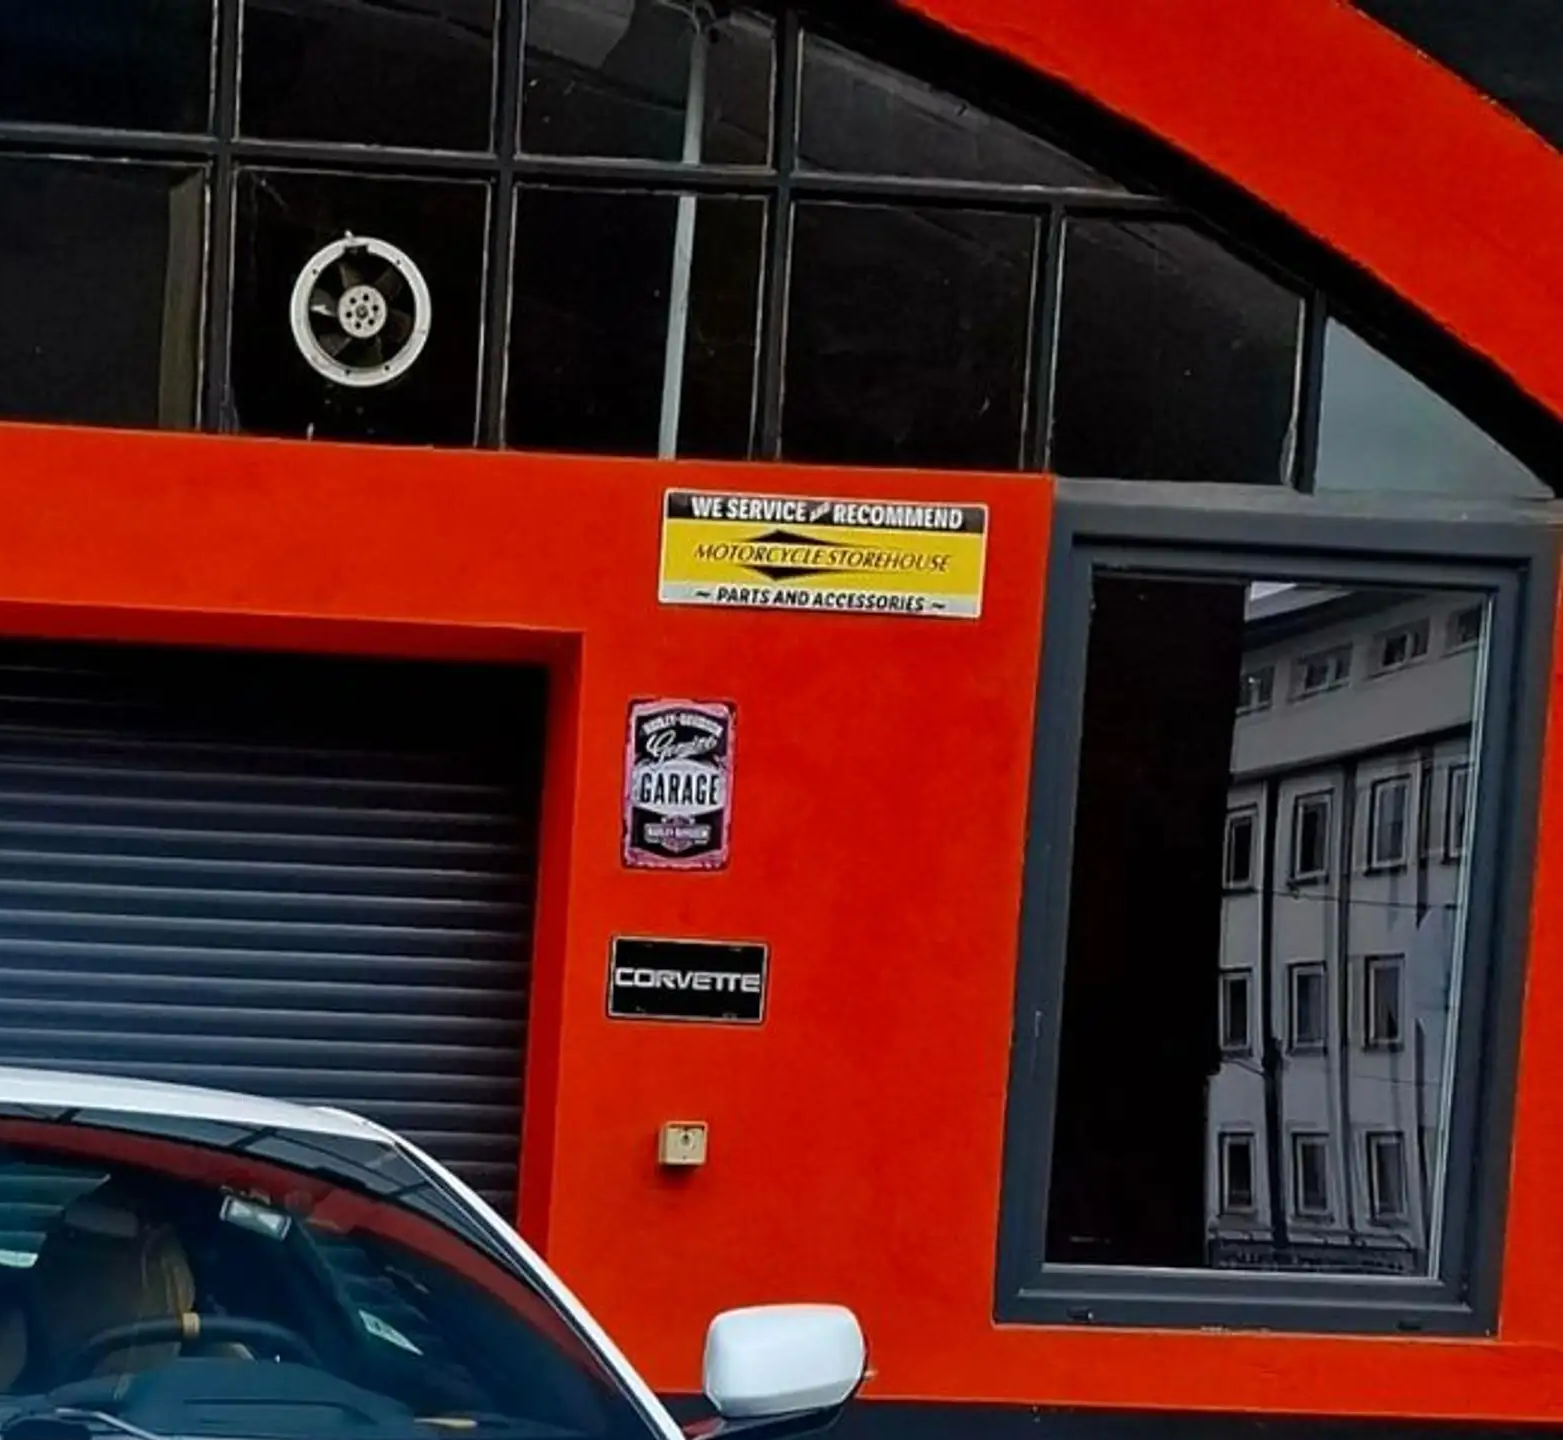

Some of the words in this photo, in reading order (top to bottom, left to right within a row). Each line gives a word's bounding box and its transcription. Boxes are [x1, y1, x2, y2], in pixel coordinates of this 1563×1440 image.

[691, 496, 726, 518] WE
[727, 498, 807, 523] SERVICE
[832, 504, 964, 530] RECOMMEND
[694, 543, 825, 567] MOTORCYCLE
[827, 548, 952, 573] STOREHOUSE
[716, 586, 771, 604] PARTS
[774, 589, 810, 607] AND
[812, 591, 926, 612] ACCESSORIES
[640, 772, 721, 806] GARAGE
[615, 967, 761, 993] CORVETTE
